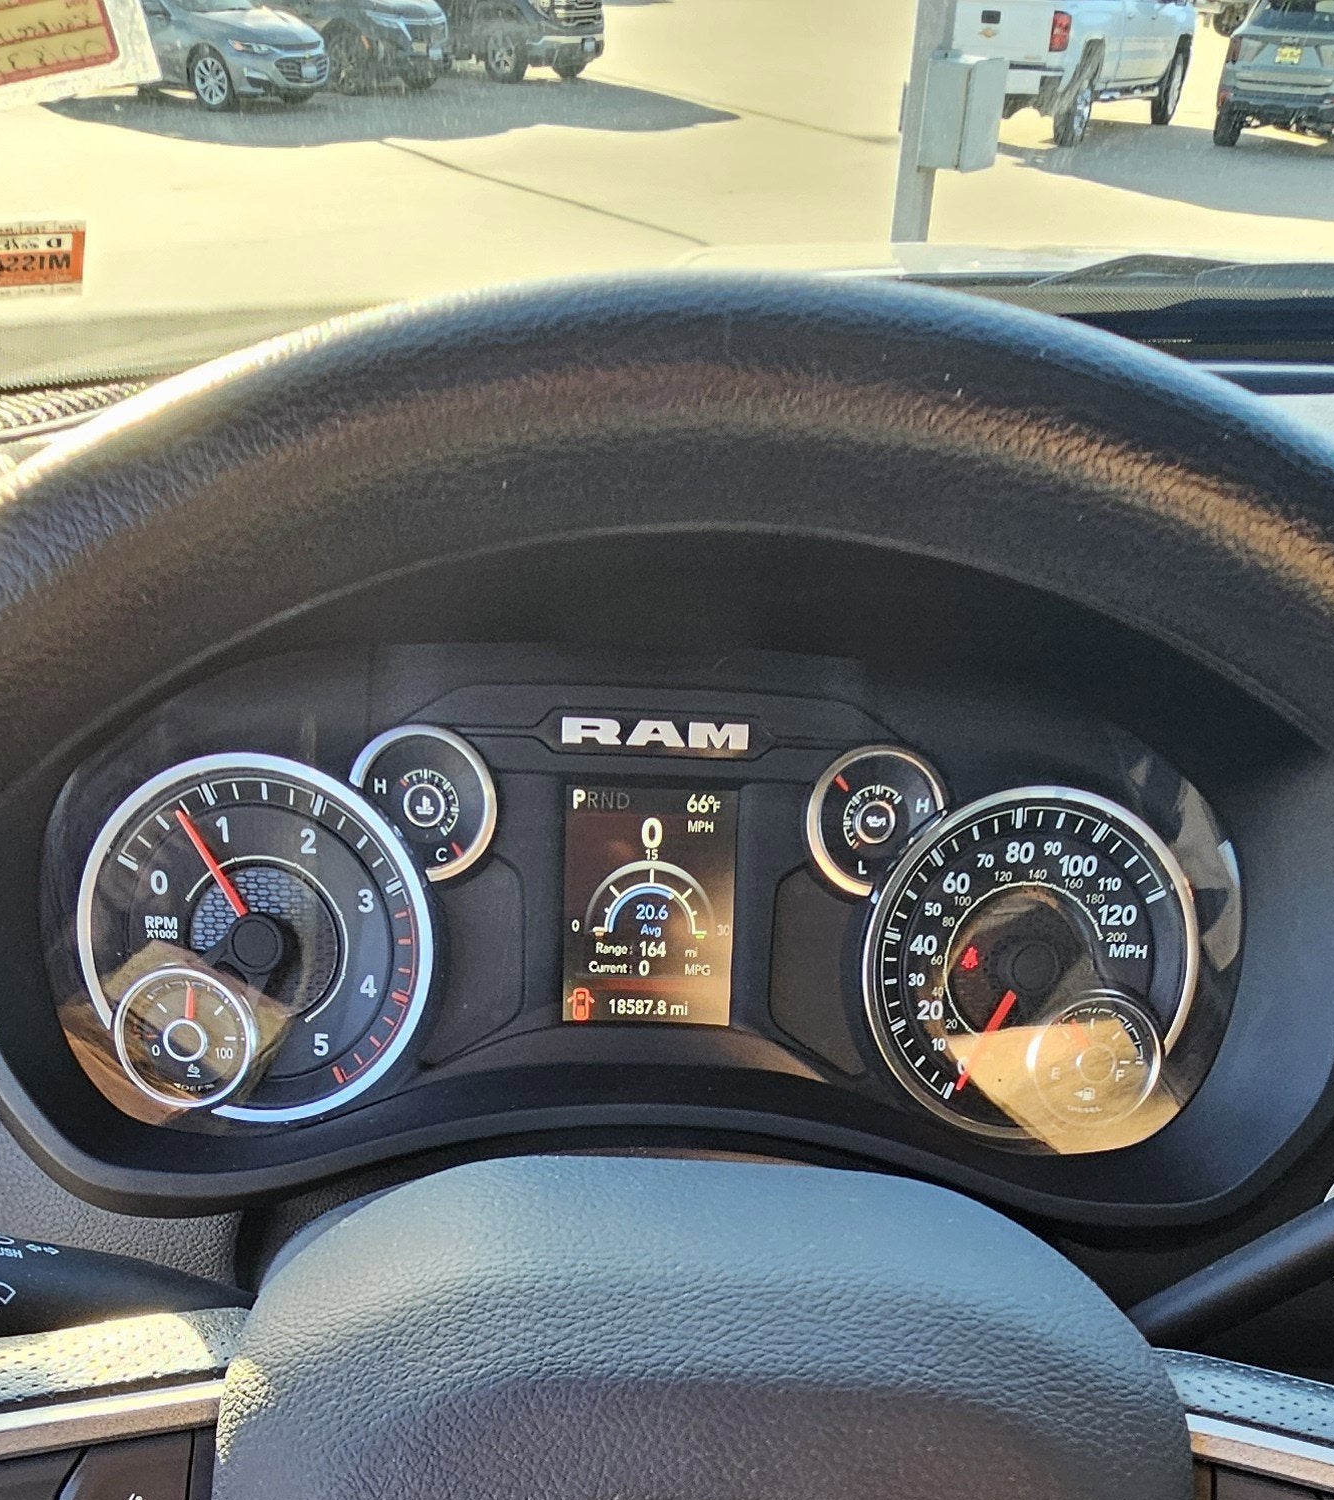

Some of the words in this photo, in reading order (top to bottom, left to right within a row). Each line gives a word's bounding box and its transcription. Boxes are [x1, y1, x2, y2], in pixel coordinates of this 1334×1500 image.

[562, 717, 749, 749] RAM
[374, 778, 387, 793] H
[915, 799, 930, 813] H
[216, 817, 229, 843] 1
[641, 817, 663, 849] 0
[687, 820, 714, 833] MPH
[300, 829, 317, 854] 2
[1043, 841, 1062, 856] 90
[436, 848, 448, 862] C
[645, 848, 659, 860] 15
[1006, 841, 1035, 864] 80
[858, 861, 867, 875] L
[977, 853, 995, 868] 70
[1058, 854, 1098, 877] 100
[994, 870, 1013, 882] 120
[1028, 869, 1048, 880] 140
[150, 872, 169, 896] 0
[942, 871, 971, 894] 60
[1064, 878, 1084, 889] 160
[1098, 877, 1122, 892] 110
[358, 890, 374, 914] 3
[954, 895, 972, 907] 100
[1085, 893, 1105, 904] 180
[635, 904, 669, 921] 20.6
[924, 901, 942, 917] 50
[1097, 904, 1138, 926] 120
[145, 915, 178, 930] RPM
[571, 919, 580, 932] 0
[942, 916, 955, 927] 80
[146, 927, 178, 940] X1000
[640, 925, 662, 937] Avg
[1106, 932, 1127, 943] 200
[639, 941, 667, 958] 164
[685, 948, 698, 958] mi
[909, 934, 938, 956] 40
[1108, 943, 1148, 959] MPH
[930, 955, 943, 966] 60
[638, 960, 650, 977] 0
[684, 963, 711, 976] MPG
[360, 974, 377, 998] 4
[908, 973, 926, 987] 30
[608, 998, 667, 1016] 18587.8
[669, 1001, 688, 1016] mi
[917, 1000, 944, 1020] 20
[945, 1019, 958, 1030] 20
[151, 1044, 161, 1057] 0
[313, 1034, 329, 1056] 5
[931, 1037, 947, 1052] 10
[215, 1048, 234, 1060] 100
